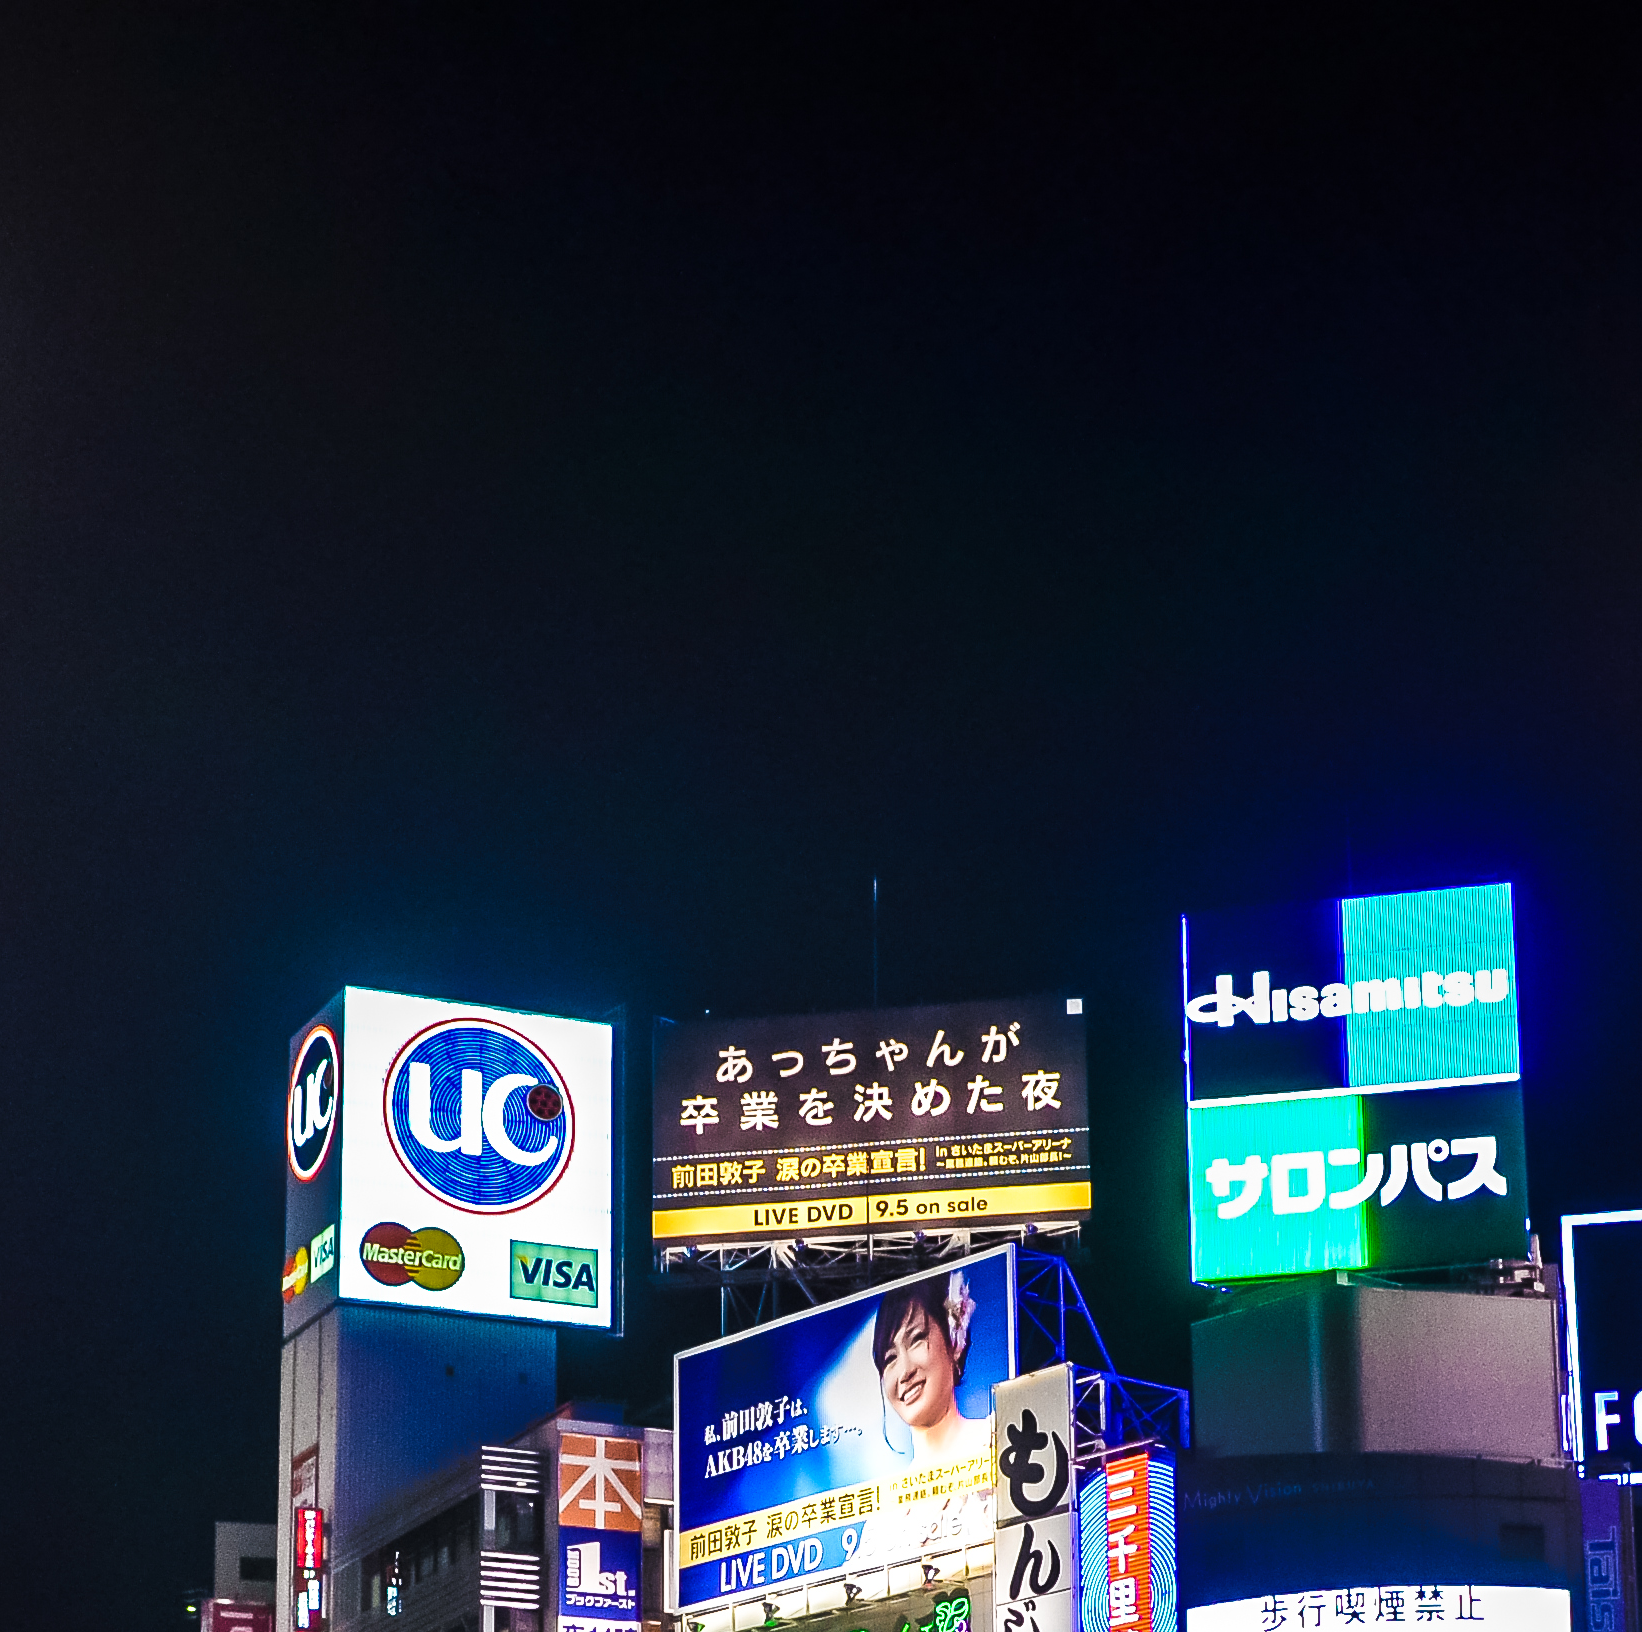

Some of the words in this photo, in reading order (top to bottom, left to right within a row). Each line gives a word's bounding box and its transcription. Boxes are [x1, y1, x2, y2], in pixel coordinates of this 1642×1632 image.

[1186, 968, 1510, 1028] Hisamitsu
[715, 1021, 1022, 1084] あっちゃんが
[679, 1070, 1063, 1135] 卒業を決めた夜
[671, 1157, 766, 1190] 前田敦子
[776, 1146, 927, 1184] 涙の卒業宣言!
[1206, 1135, 1508, 1219] サロンパス
[754, 1206, 799, 1228] LIVE
[807, 1203, 854, 1224] DVD
[875, 1199, 909, 1218] 9.5
[915, 1200, 941, 1215] on
[946, 1194, 989, 1213] sale
[361, 1241, 465, 1273] MasterCard
[518, 1259, 596, 1293] VISA
[559, 1437, 642, 1529] 本
[690, 1523, 759, 1561] 前田敦子
[766, 1484, 881, 1539] 涙の卒業宣言!
[719, 1551, 766, 1594] LIVE
[770, 1534, 824, 1575] DVD
[1260, 1585, 1485, 1632] 歩行喫煙禁止
